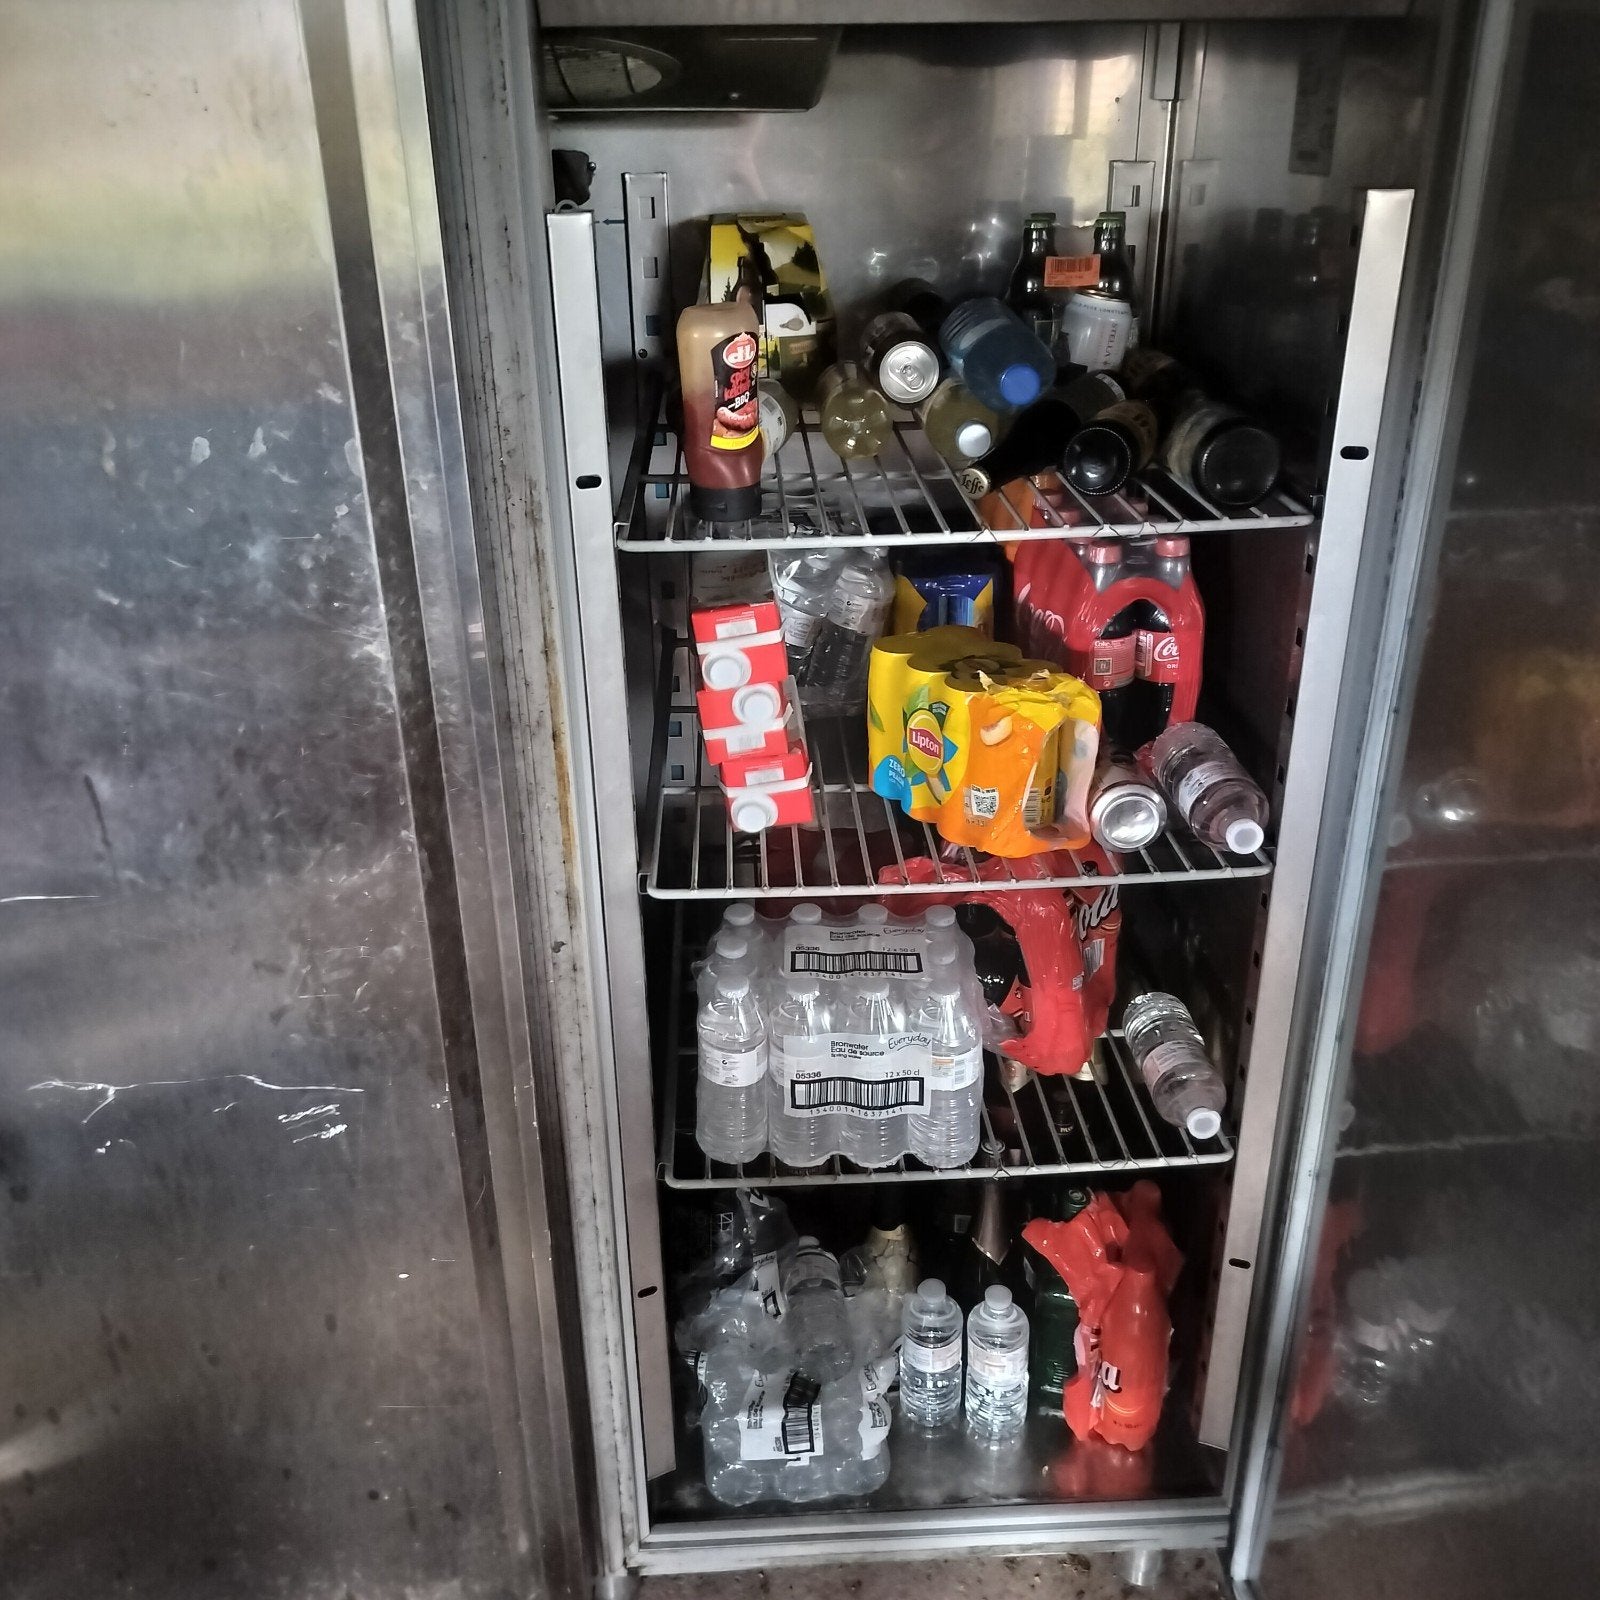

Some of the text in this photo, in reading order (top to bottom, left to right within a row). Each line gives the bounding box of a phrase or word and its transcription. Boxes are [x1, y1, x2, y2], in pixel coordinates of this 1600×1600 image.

[1105, 323, 1118, 357] STELLA
[735, 391, 750, 409] BBQ
[961, 474, 984, 494] Leffe
[912, 731, 939, 755] Lipton
[889, 758, 906, 778] ZERO
[883, 927, 925, 937] Everyday
[831, 1040, 869, 1051] Bronwater
[888, 1033, 931, 1050] Everyday
[795, 1071, 822, 1080] 05336
